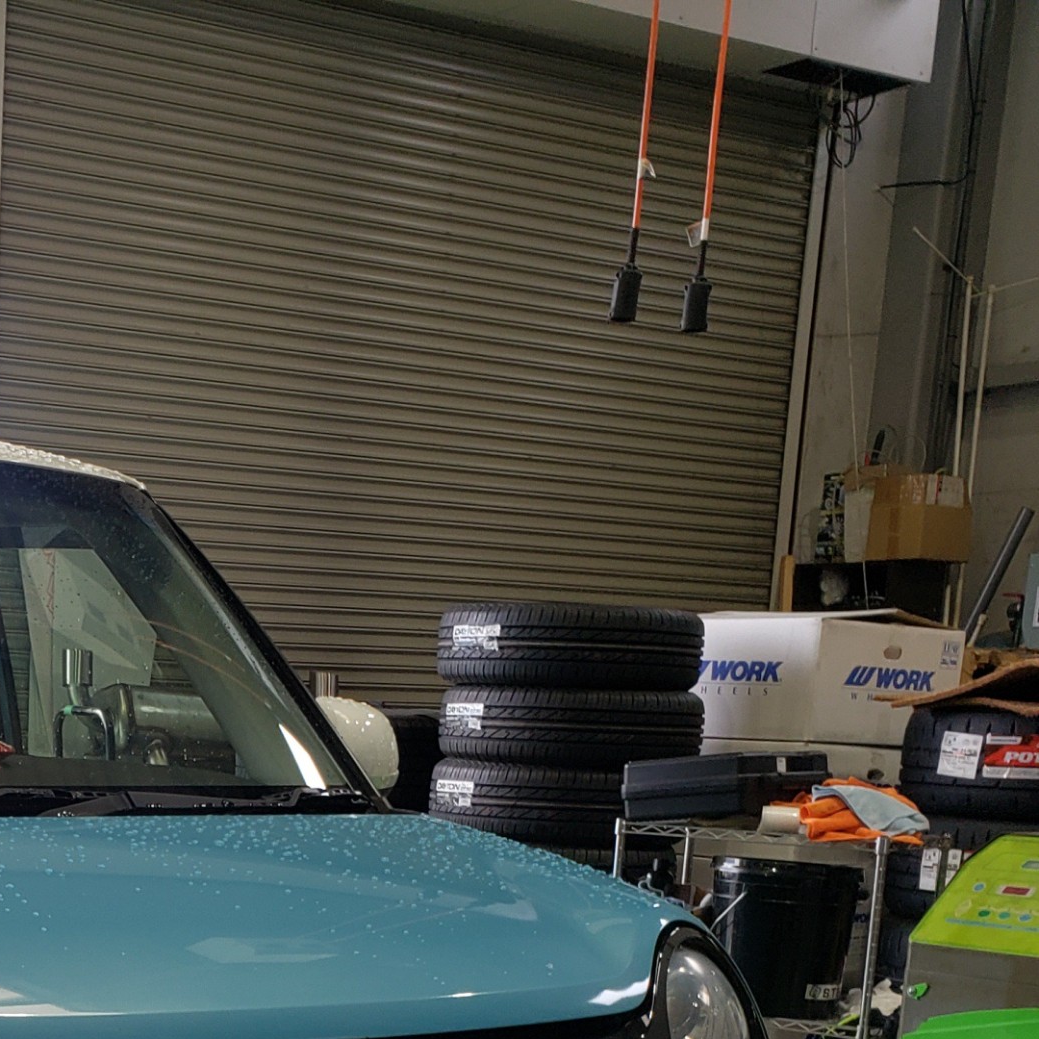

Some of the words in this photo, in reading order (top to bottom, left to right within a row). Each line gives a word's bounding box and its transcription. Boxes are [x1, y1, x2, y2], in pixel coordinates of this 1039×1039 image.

[711, 660, 783, 682] WORK
[876, 667, 935, 691] WORK
[700, 686, 768, 696] HEELS
